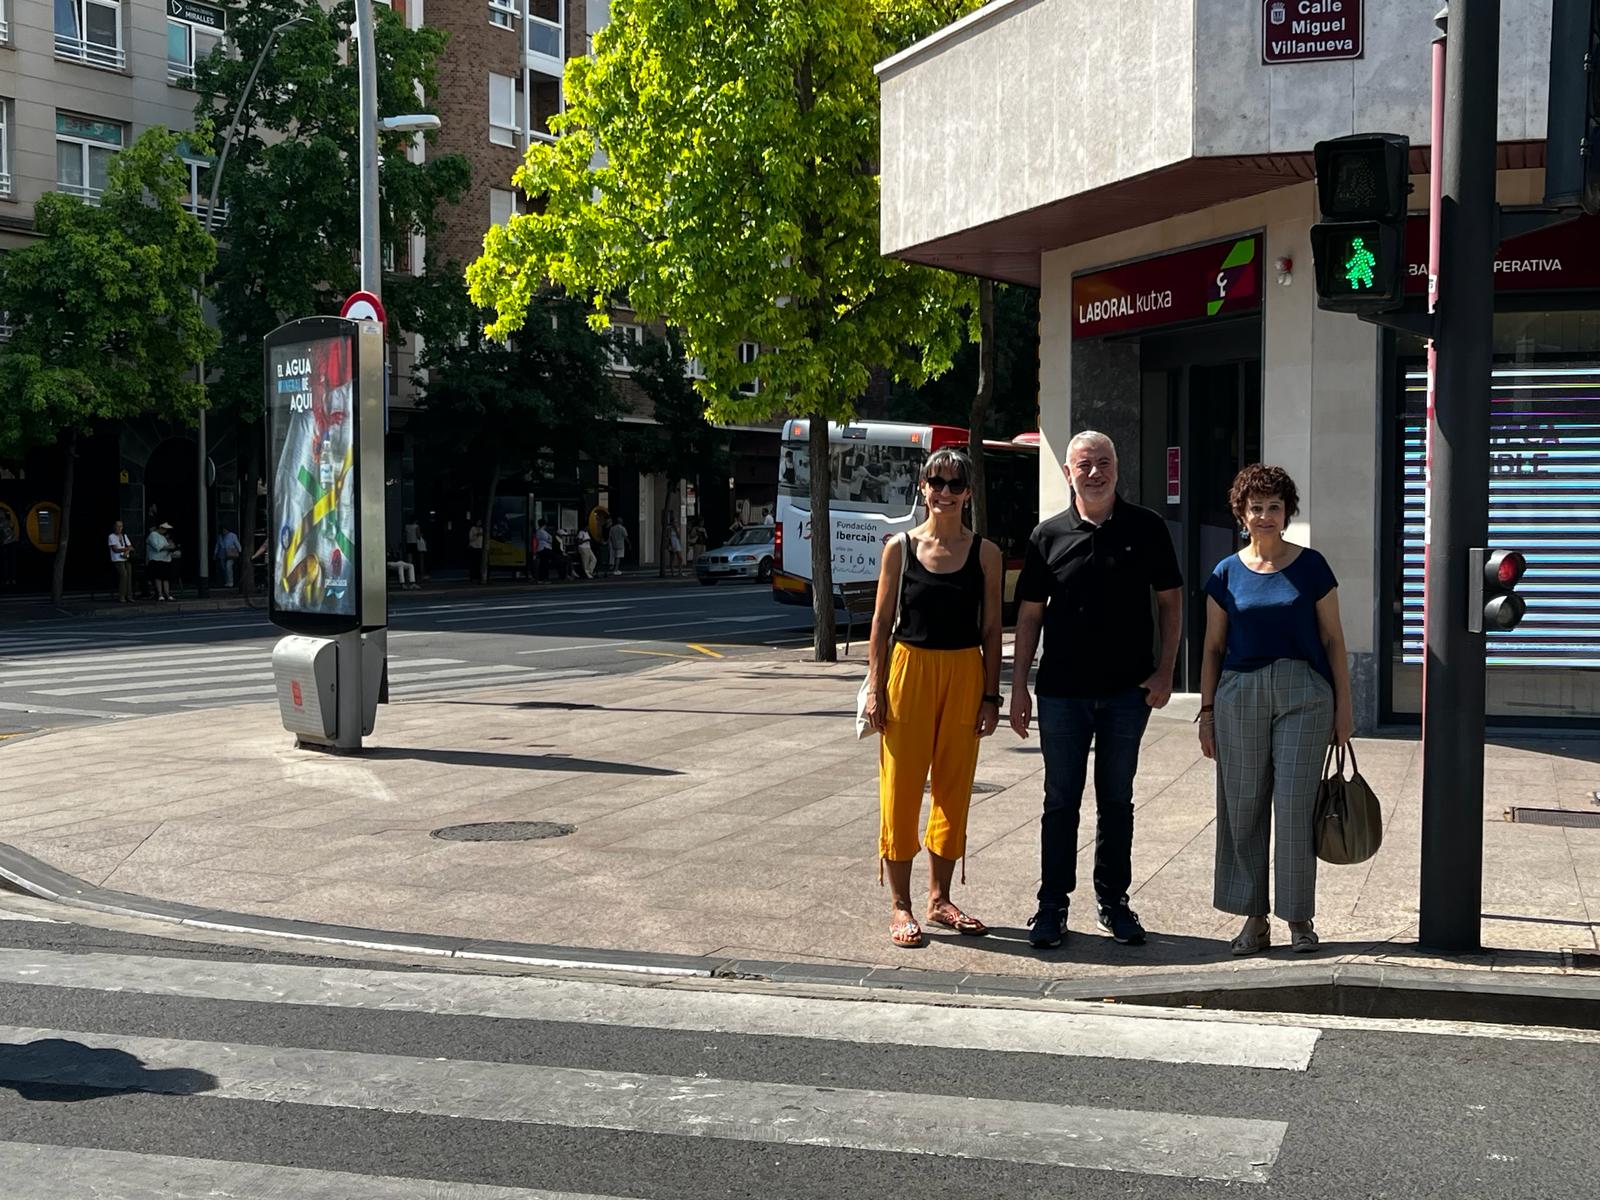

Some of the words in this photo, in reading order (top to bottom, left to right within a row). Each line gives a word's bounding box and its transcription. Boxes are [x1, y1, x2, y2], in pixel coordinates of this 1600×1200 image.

[1298, 0, 1342, 14] Calle
[185, 11, 215, 25] MIRALLES
[1292, 18, 1345, 35] Miguel
[1272, 40, 1353, 54] Villanueva
[1493, 259, 1562, 272] PERATIVA
[1079, 297, 1134, 324] LABORAL
[1136, 289, 1172, 313] kutxa
[277, 364, 284, 377] EL
[285, 358, 312, 377] AGUA
[301, 377, 309, 391] DE
[836, 521, 877, 531] Fundación
[836, 531, 876, 544] Ibercaja
